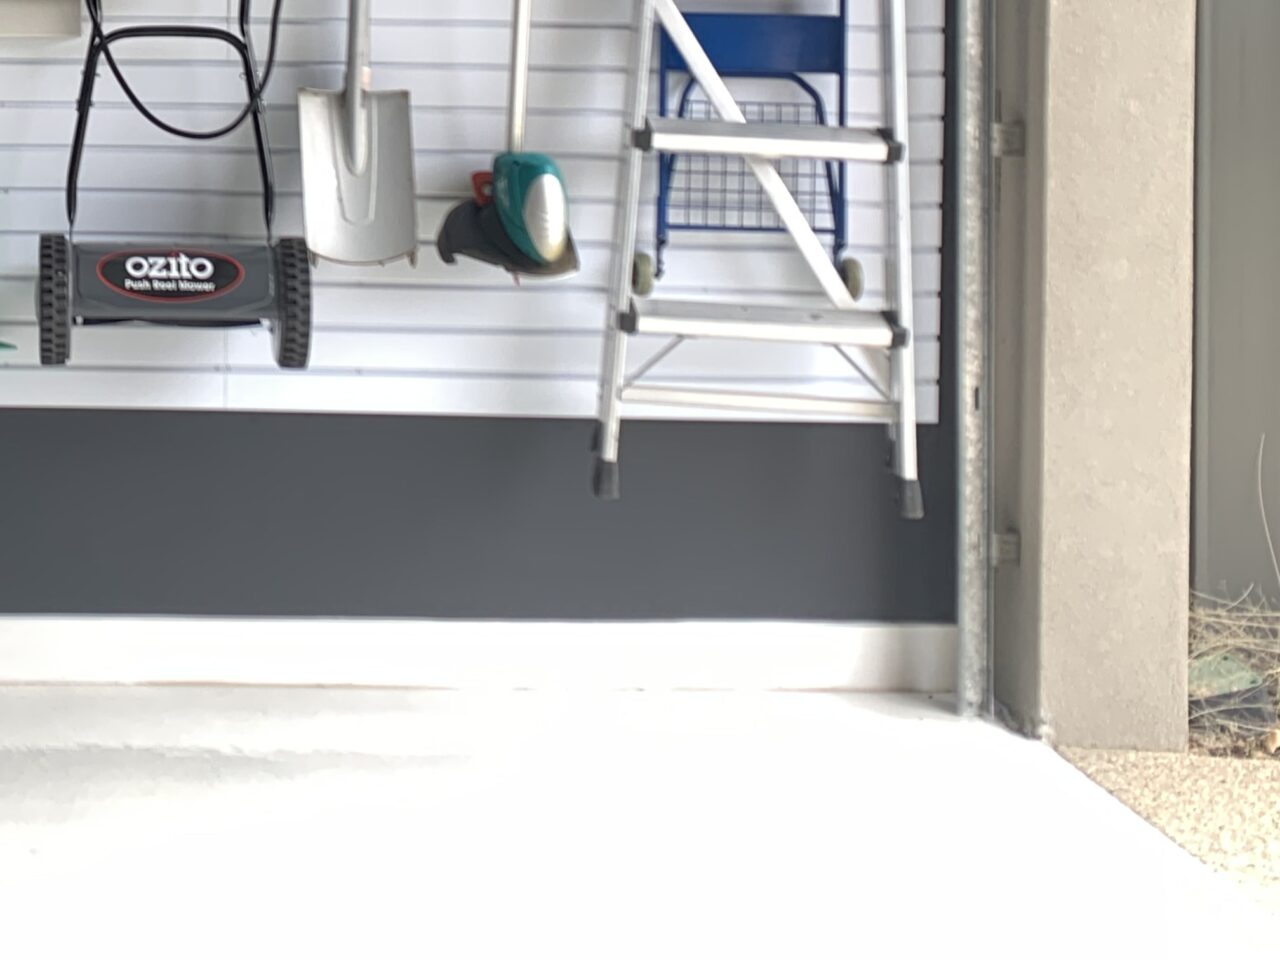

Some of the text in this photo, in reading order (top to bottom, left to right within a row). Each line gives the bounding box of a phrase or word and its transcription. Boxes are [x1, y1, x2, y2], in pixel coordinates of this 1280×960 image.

[125, 251, 214, 280] ozito
[124, 278, 216, 292] Push Reel Mower
